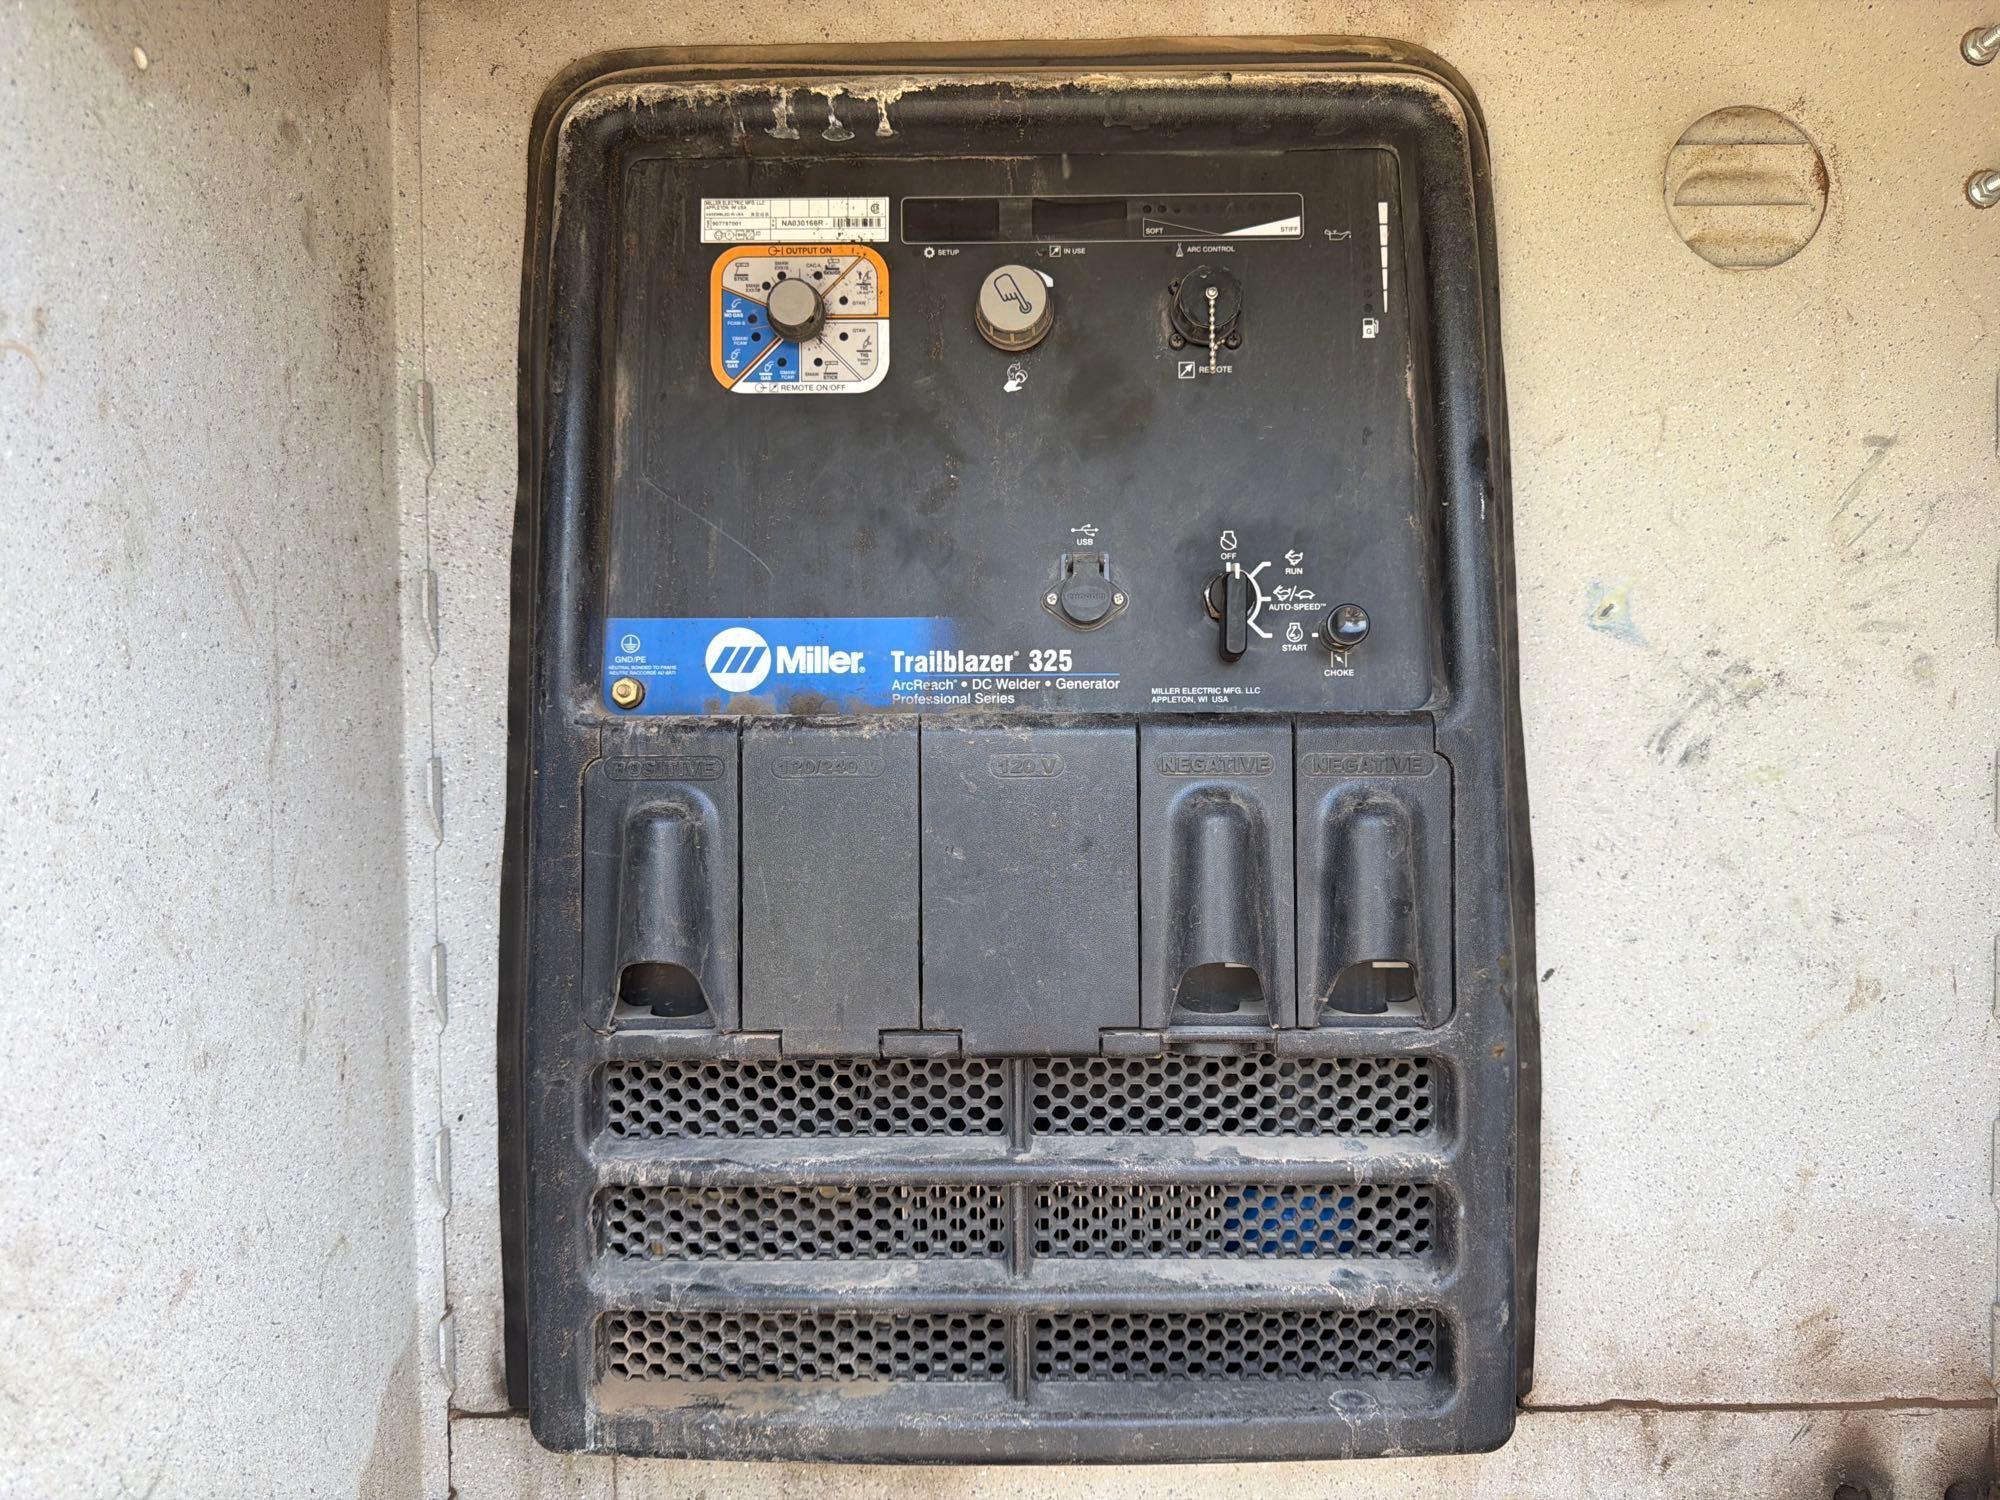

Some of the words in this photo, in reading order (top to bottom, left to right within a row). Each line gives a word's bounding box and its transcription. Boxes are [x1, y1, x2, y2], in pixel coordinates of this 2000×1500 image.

[786, 247, 817, 255] OUTPUT
[820, 247, 832, 255] ON
[1199, 366, 1233, 374] REOTE
[1076, 538, 1094, 546] USB
[1220, 552, 1237, 560] OFF
[1029, 650, 1073, 672] 325
[1324, 669, 1355, 677] CHOKE
[972, 679, 992, 690] DC
[997, 678, 1040, 690] Welder
[1056, 678, 1120, 690] Generator
[892, 693, 971, 704] Professional
[975, 692, 1015, 704] Series
[1151, 696, 1196, 704] APPLETON,
[613, 760, 718, 777] POSITIVE
[1000, 759, 1036, 774] 120
[1041, 758, 1057, 775] V
[1161, 757, 1269, 773] NEGATIVE
[1311, 758, 1421, 773] NEGATIVE
